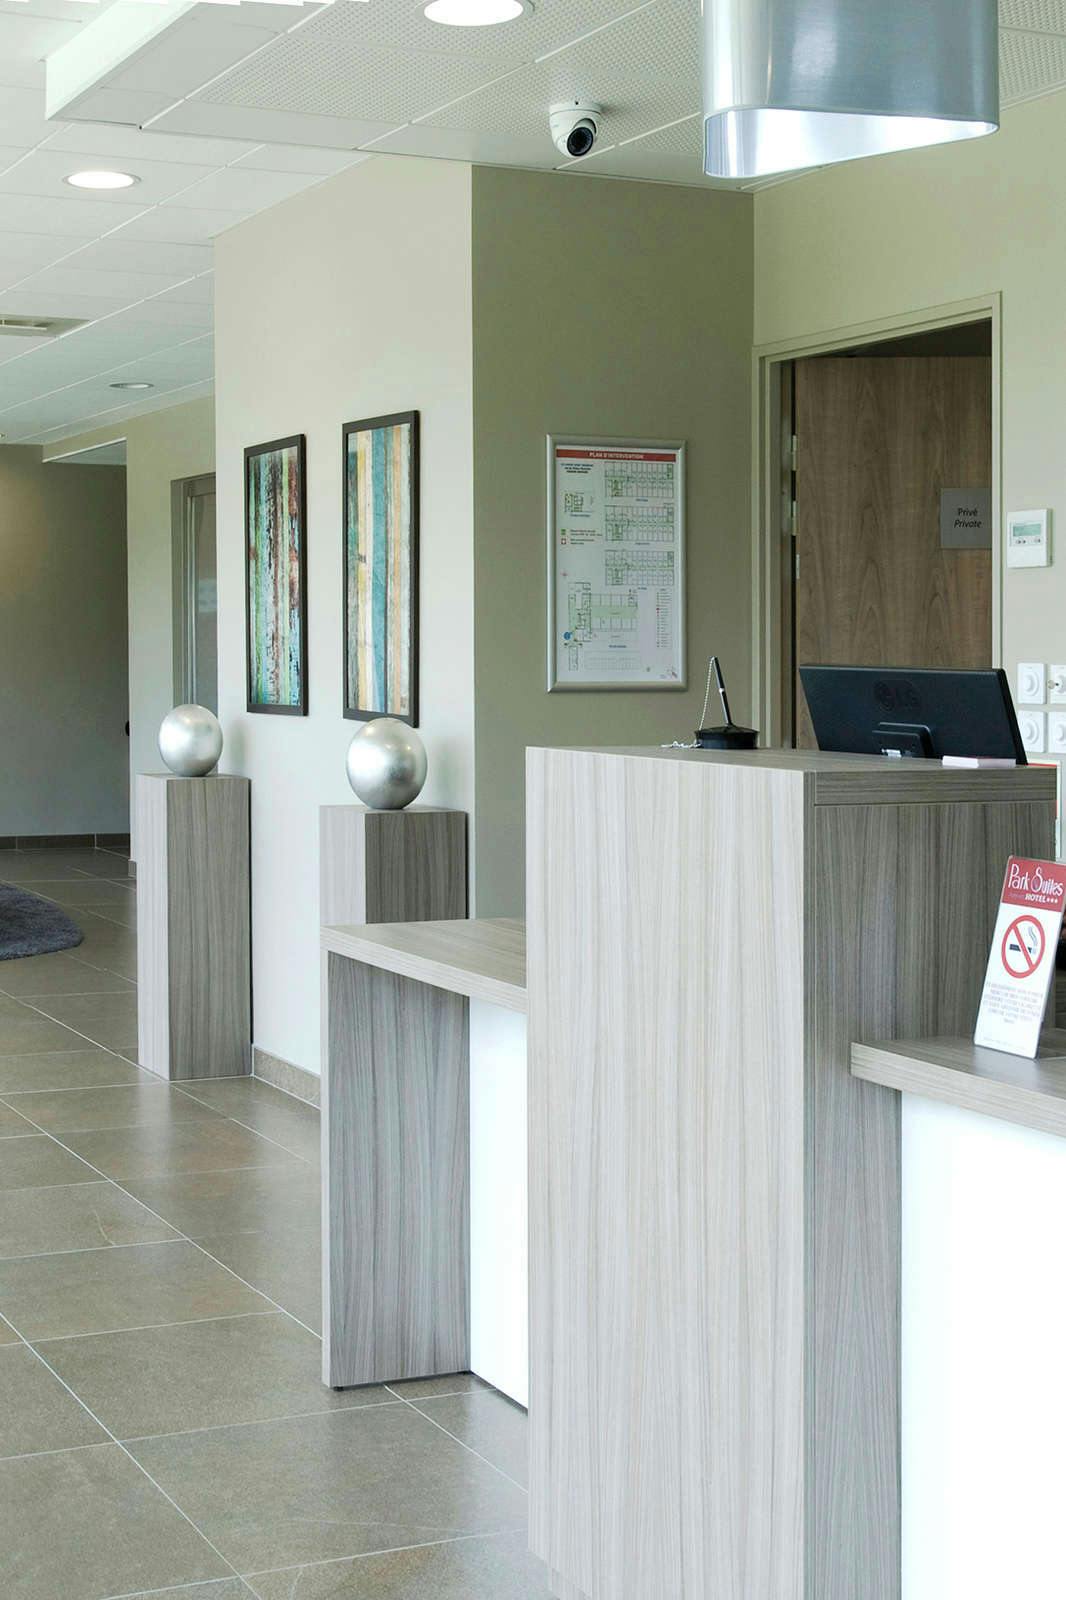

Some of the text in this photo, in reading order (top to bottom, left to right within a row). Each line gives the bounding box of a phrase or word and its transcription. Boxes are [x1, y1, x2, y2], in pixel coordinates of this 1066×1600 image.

[957, 507, 978, 516] Privé
[953, 519, 982, 528] Private
[1008, 863, 1064, 896] Park Suites
